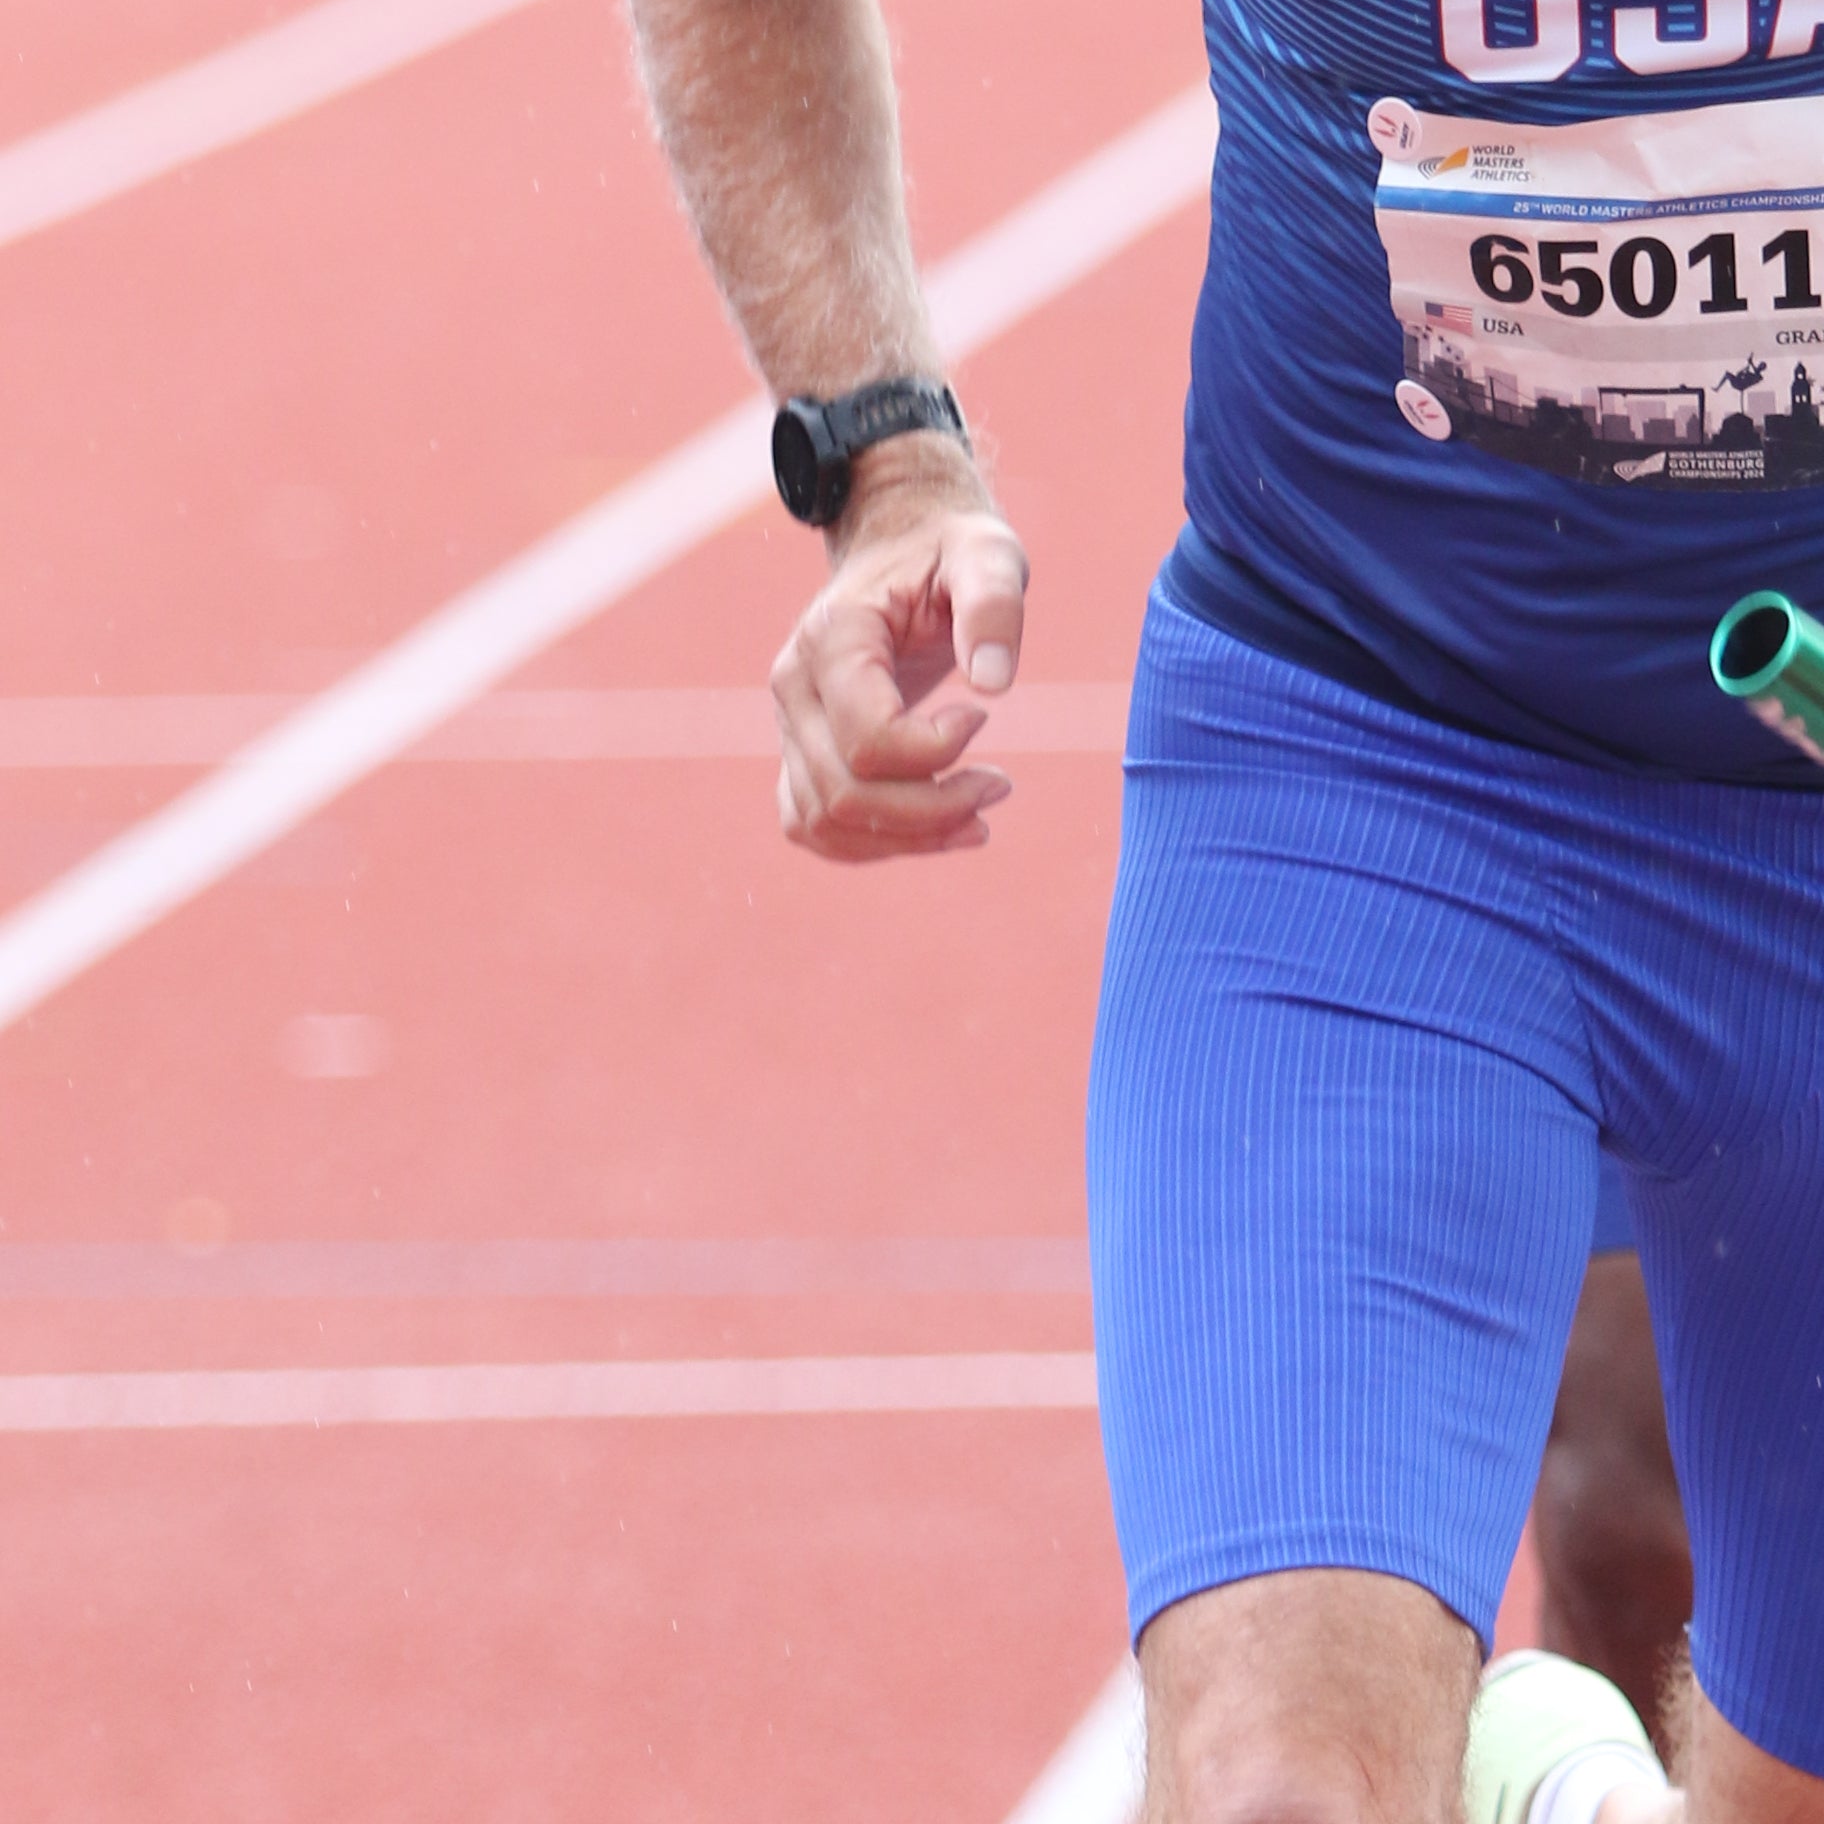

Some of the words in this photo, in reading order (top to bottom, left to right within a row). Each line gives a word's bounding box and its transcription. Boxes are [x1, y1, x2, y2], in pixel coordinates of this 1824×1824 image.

[1472, 145, 1515, 155] WORLD
[1472, 156, 1525, 169] MASTERS
[1471, 170, 1529, 182] ATHLETICS
[1541, 203, 1588, 216] WORLD
[1590, 205, 1653, 217] MASTERS
[1656, 198, 1728, 214] ATHLETICS
[1483, 318, 1524, 336] USA
[1669, 459, 1764, 469] GOTHENBURG
